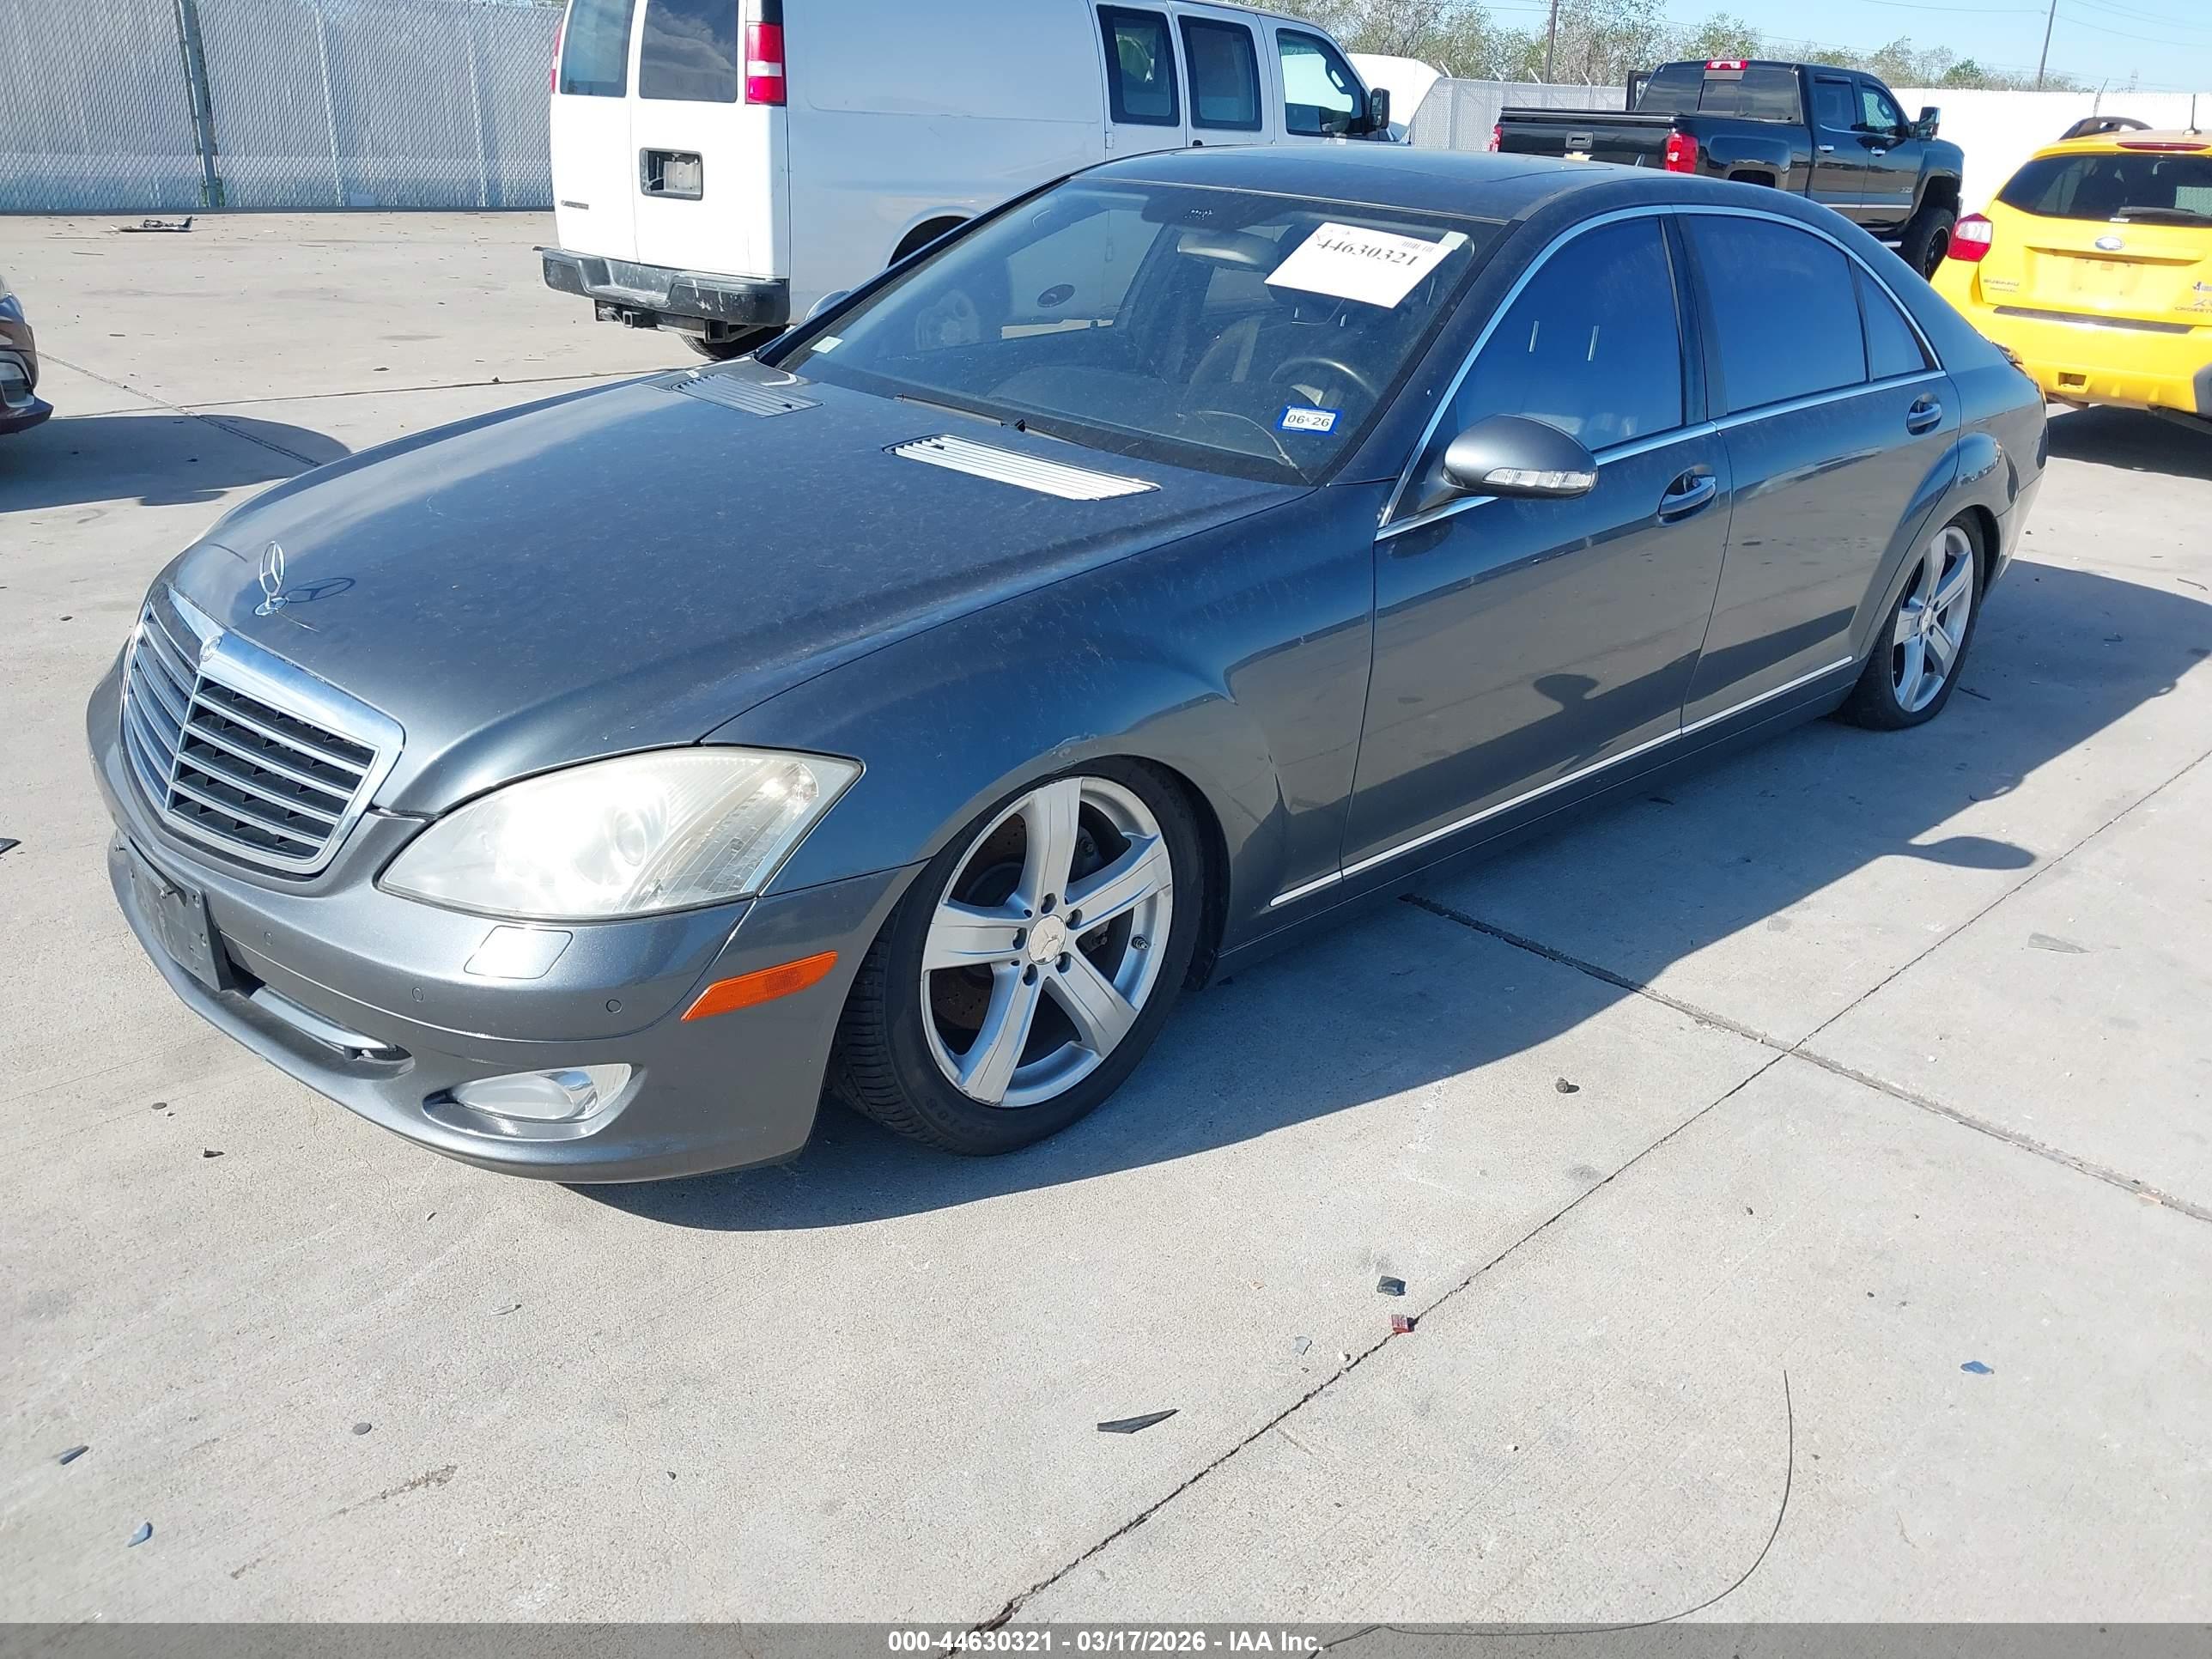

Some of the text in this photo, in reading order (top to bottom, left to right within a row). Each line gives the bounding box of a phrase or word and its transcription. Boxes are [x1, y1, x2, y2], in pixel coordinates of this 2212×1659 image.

[1316, 239, 1419, 266] 44630321
[1287, 415, 1330, 428] 06 26
